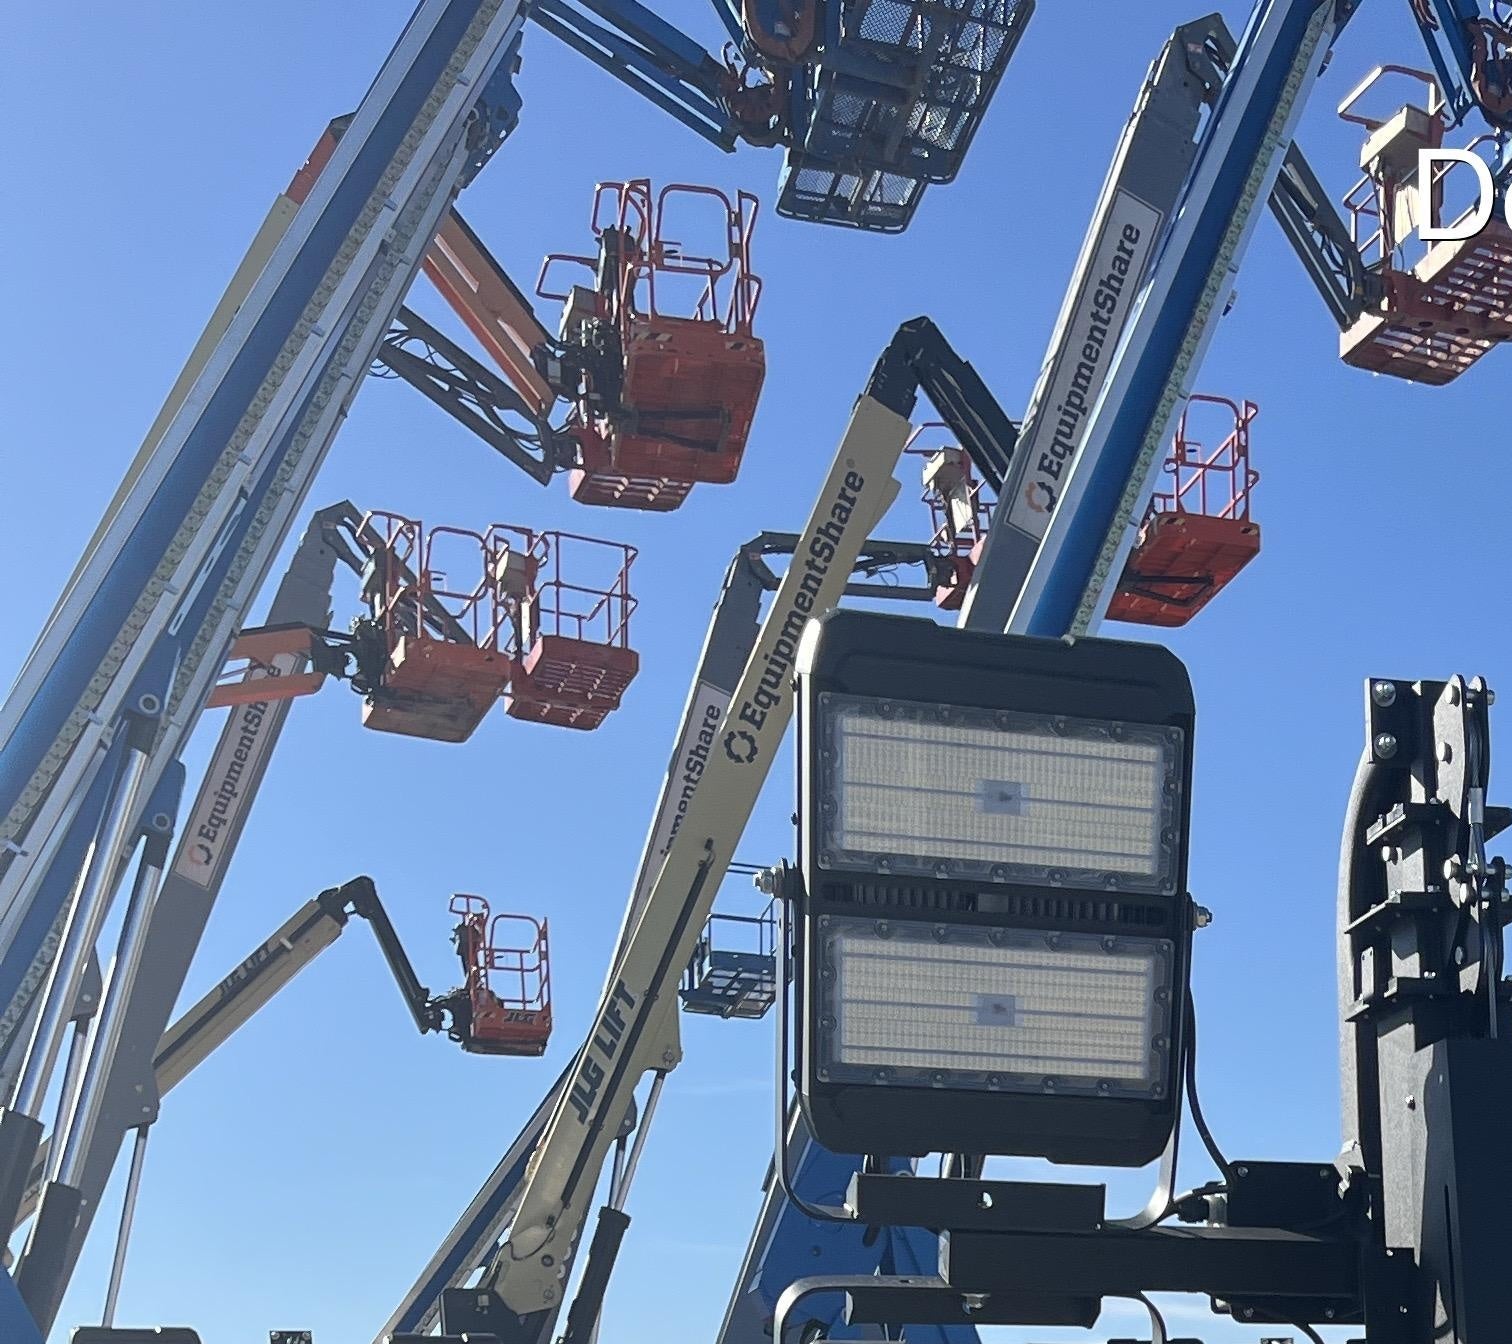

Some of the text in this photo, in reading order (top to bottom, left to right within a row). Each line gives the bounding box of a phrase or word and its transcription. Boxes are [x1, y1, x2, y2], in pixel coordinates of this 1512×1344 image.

[1037, 223, 1141, 481] EquipmentShare
[739, 467, 864, 731] EquipmentShare
[199, 663, 282, 843] EquipmentShe
[568, 979, 636, 1126] JLG LIFT
